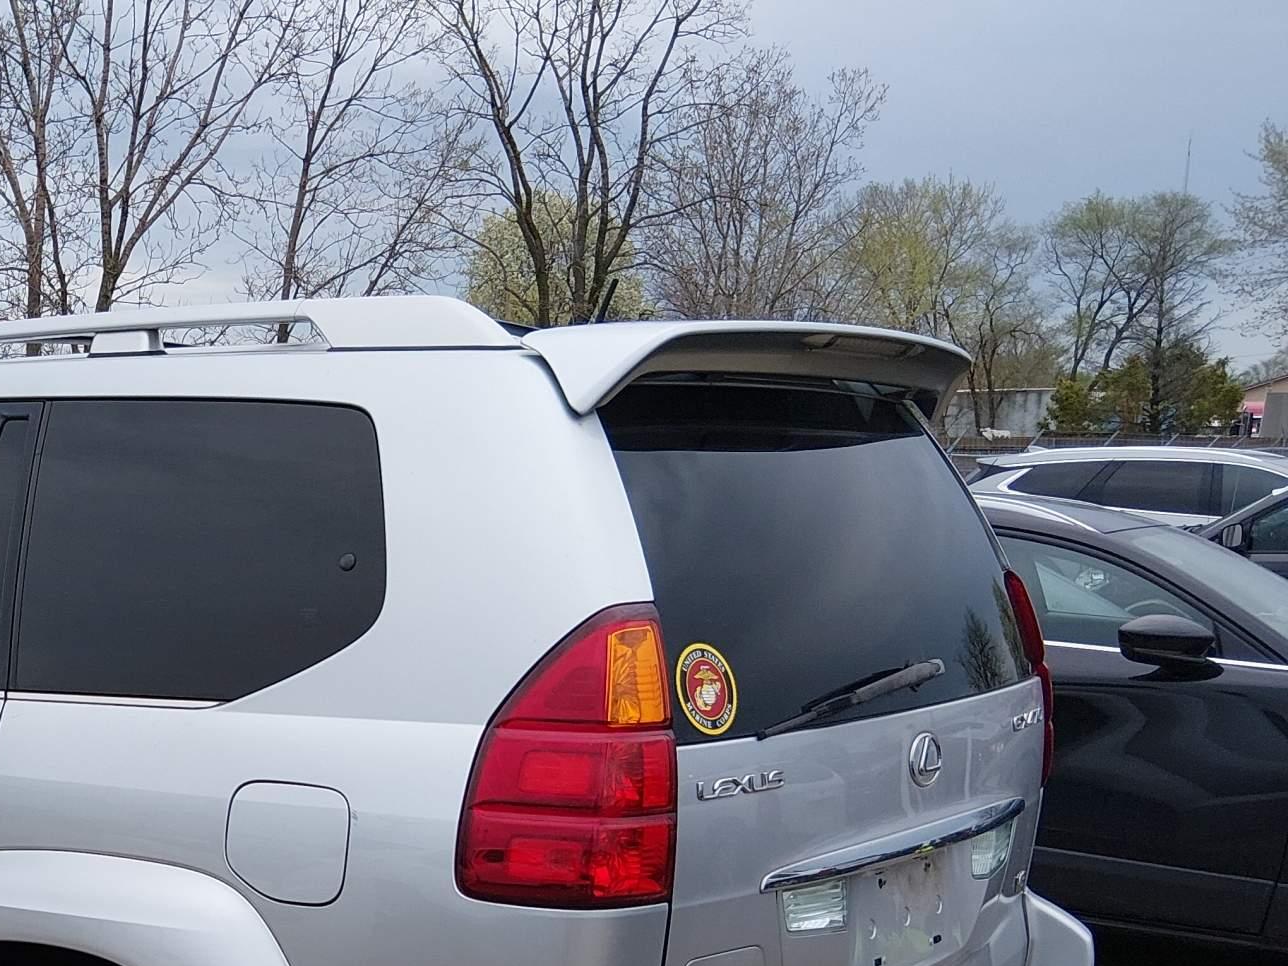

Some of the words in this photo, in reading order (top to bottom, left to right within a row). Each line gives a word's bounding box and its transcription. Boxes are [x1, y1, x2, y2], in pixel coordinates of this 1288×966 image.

[682, 650, 703, 673] UNITED
[703, 650, 726, 673] STATES
[686, 702, 713, 729] MARINE
[715, 703, 732, 728] CORPS
[697, 770, 785, 801] LEXUS
